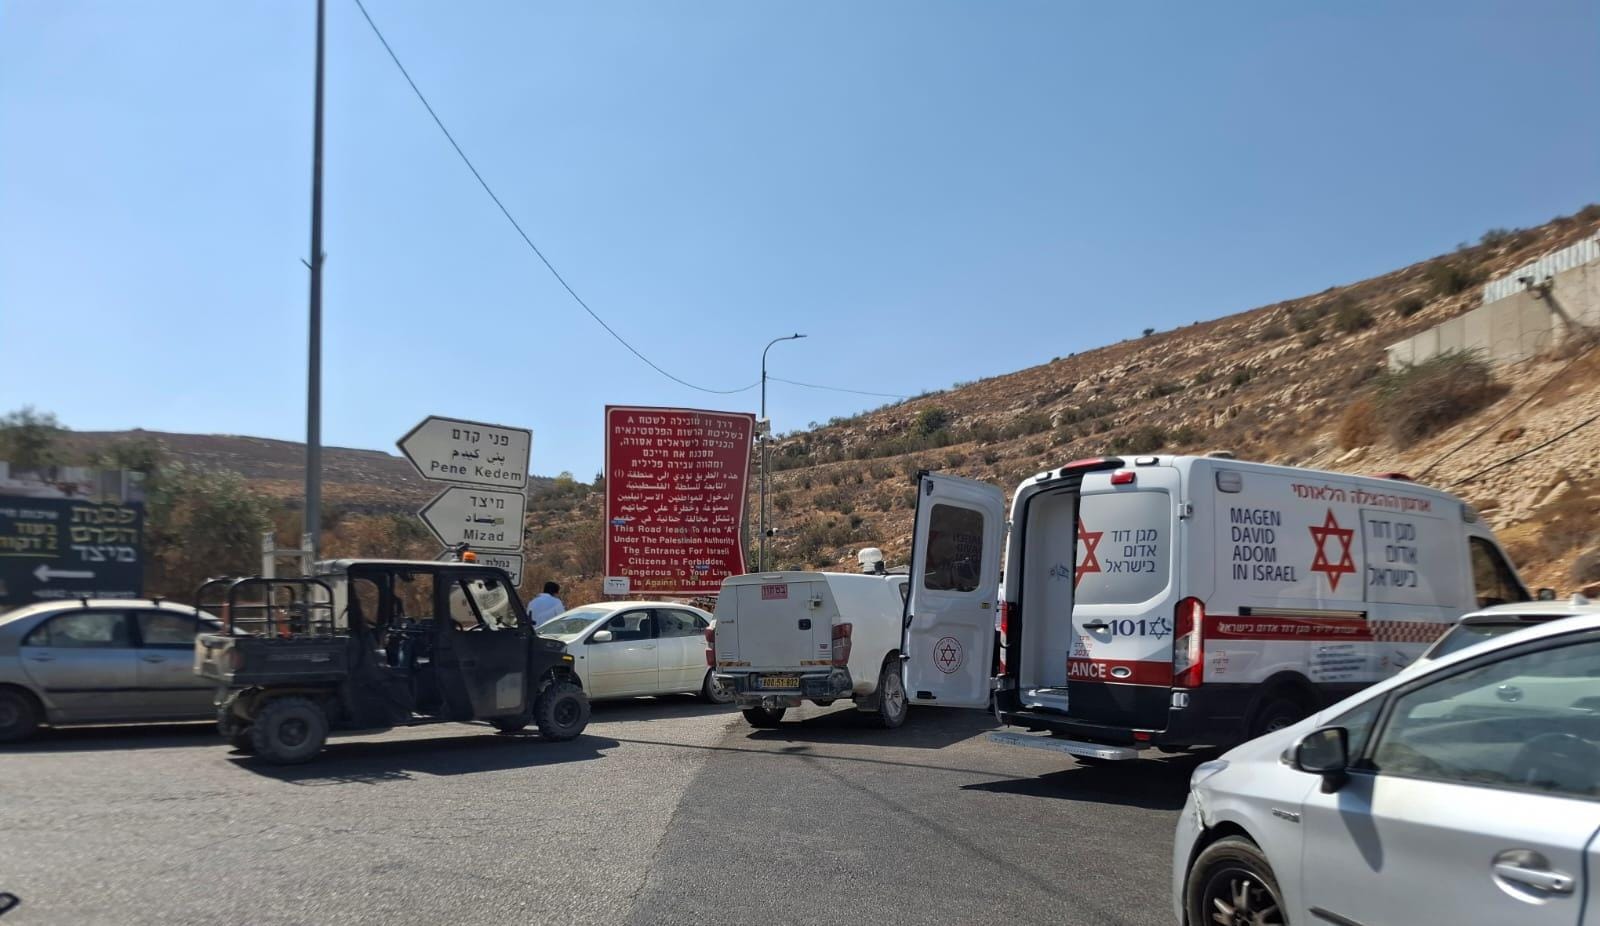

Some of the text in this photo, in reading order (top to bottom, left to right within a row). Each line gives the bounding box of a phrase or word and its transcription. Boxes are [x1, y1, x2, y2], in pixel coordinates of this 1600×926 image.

[670, 417, 700, 425] מובילה
[717, 421, 732, 429] דרך
[452, 428, 510, 446] פני קדם
[677, 428, 703, 436] הרשות
[708, 429, 743, 440] בשליטת
[620, 436, 734, 448] הכניסה לישראלים אסורה,
[643, 449, 713, 458] מסכנת את חייכם
[632, 459, 663, 468] פלילית
[667, 460, 693, 469] עבירה
[431, 460, 522, 481] Pene Kedem
[1291, 484, 1346, 502] הלאומי
[470, 496, 504, 509] מיצד
[1230, 507, 1281, 526] MAGEN
[464, 529, 504, 542] Mizad
[614, 525, 634, 533] This
[638, 525, 661, 533] Road
[666, 526, 688, 534] leads
[1231, 526, 1275, 544] DAVID
[1368, 519, 1416, 542] מגן דוד
[659, 536, 702, 544] Palestinian
[704, 537, 734, 546] Authority
[1111, 530, 1158, 544] מגן דוד
[70, 545, 136, 562] מיצד
[623, 546, 640, 554] The
[644, 547, 686, 555] Entrance
[707, 547, 729, 555] Israeli
[1124, 544, 1157, 558] אדום
[1232, 545, 1277, 562] ADOM
[1385, 544, 1418, 564] אדום
[628, 557, 666, 565] Citizens
[683, 558, 726, 566] Forbidden,
[1106, 558, 1156, 573] בישראל
[622, 568, 672, 577] Dangerous
[690, 568, 708, 576] Your
[1233, 564, 1297, 582] IN ISRAEL
[1368, 564, 1418, 588] בישראל
[645, 579, 677, 587] Against
[1109, 619, 1146, 636] 101
[1218, 621, 1253, 632] בישראל
[1256, 623, 1278, 632] אדום
[1068, 662, 1106, 678] ANCE
